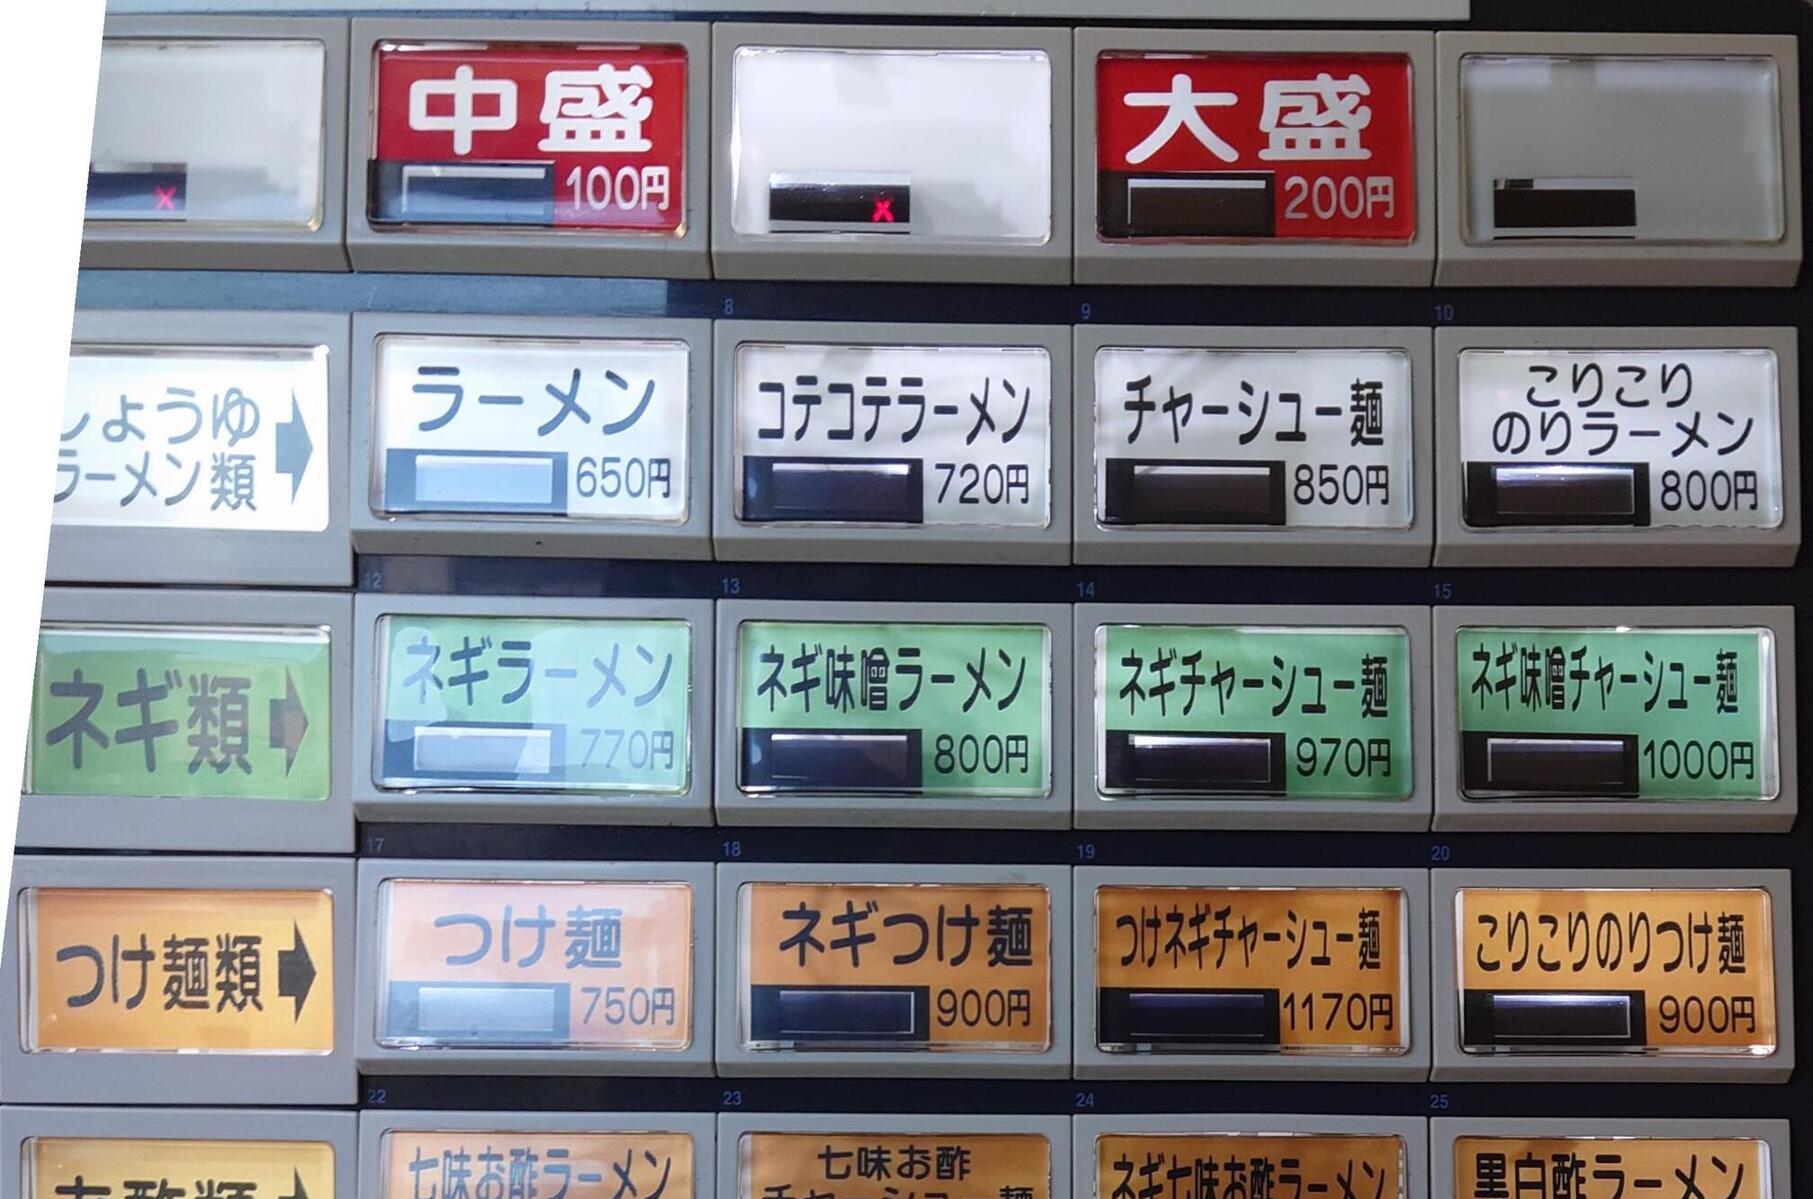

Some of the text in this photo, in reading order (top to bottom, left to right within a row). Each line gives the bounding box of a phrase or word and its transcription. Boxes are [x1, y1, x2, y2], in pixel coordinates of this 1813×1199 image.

[408, 63, 655, 155] 中盛
[1123, 73, 1373, 164] 大盛
[566, 164, 670, 212] 100円
[1284, 175, 1395, 220] 200円
[723, 298, 734, 315] 8
[1081, 303, 1091, 320] 9
[1435, 305, 1454, 321] 10
[412, 365, 656, 435] ラーメン
[1526, 363, 1693, 408] こりこり
[758, 375, 1030, 445] コテコテラーメン
[1124, 375, 1384, 448] チャーシュー麺
[1492, 410, 1753, 455] のりラーメン
[576, 457, 671, 499] 650円
[934, 463, 1029, 504] 720円
[1294, 465, 1389, 507] 850円
[1661, 470, 1757, 512] 800円
[721, 578, 740, 594] 13
[1076, 582, 1096, 598] 14
[1433, 584, 1452, 599] 15
[405, 634, 674, 708] ネギラーメン
[1119, 646, 1388, 719] ネギチャーシュー麺
[46, 668, 252, 775] ネギ類
[580, 730, 675, 771] 770円
[934, 734, 1028, 774] 800円
[1296, 736, 1391, 778] 970円
[1643, 740, 1754, 780] 1000円
[367, 837, 385, 854] 17
[723, 841, 741, 856] 18
[1076, 844, 1095, 860] 19
[1431, 846, 1451, 861] 20
[434, 906, 623, 970] つけ麺
[779, 900, 1032, 968] ネギつけ麺
[1116, 901, 1381, 972] つけネギチャーシュー麺
[1476, 909, 1745, 975] こりこりのりつけ麺
[56, 933, 263, 1014] つけ麺類
[582, 986, 675, 1026] 750円
[936, 988, 1030, 1027] 900円
[1283, 994, 1393, 1032] 1170円
[1659, 995, 1755, 1034] 900円
[368, 1089, 387, 1105] 22
[723, 1091, 741, 1106] 23
[1076, 1093, 1095, 1107] 24
[1430, 1094, 1449, 1109] 25
[818, 1145, 970, 1181] 七味お酢
